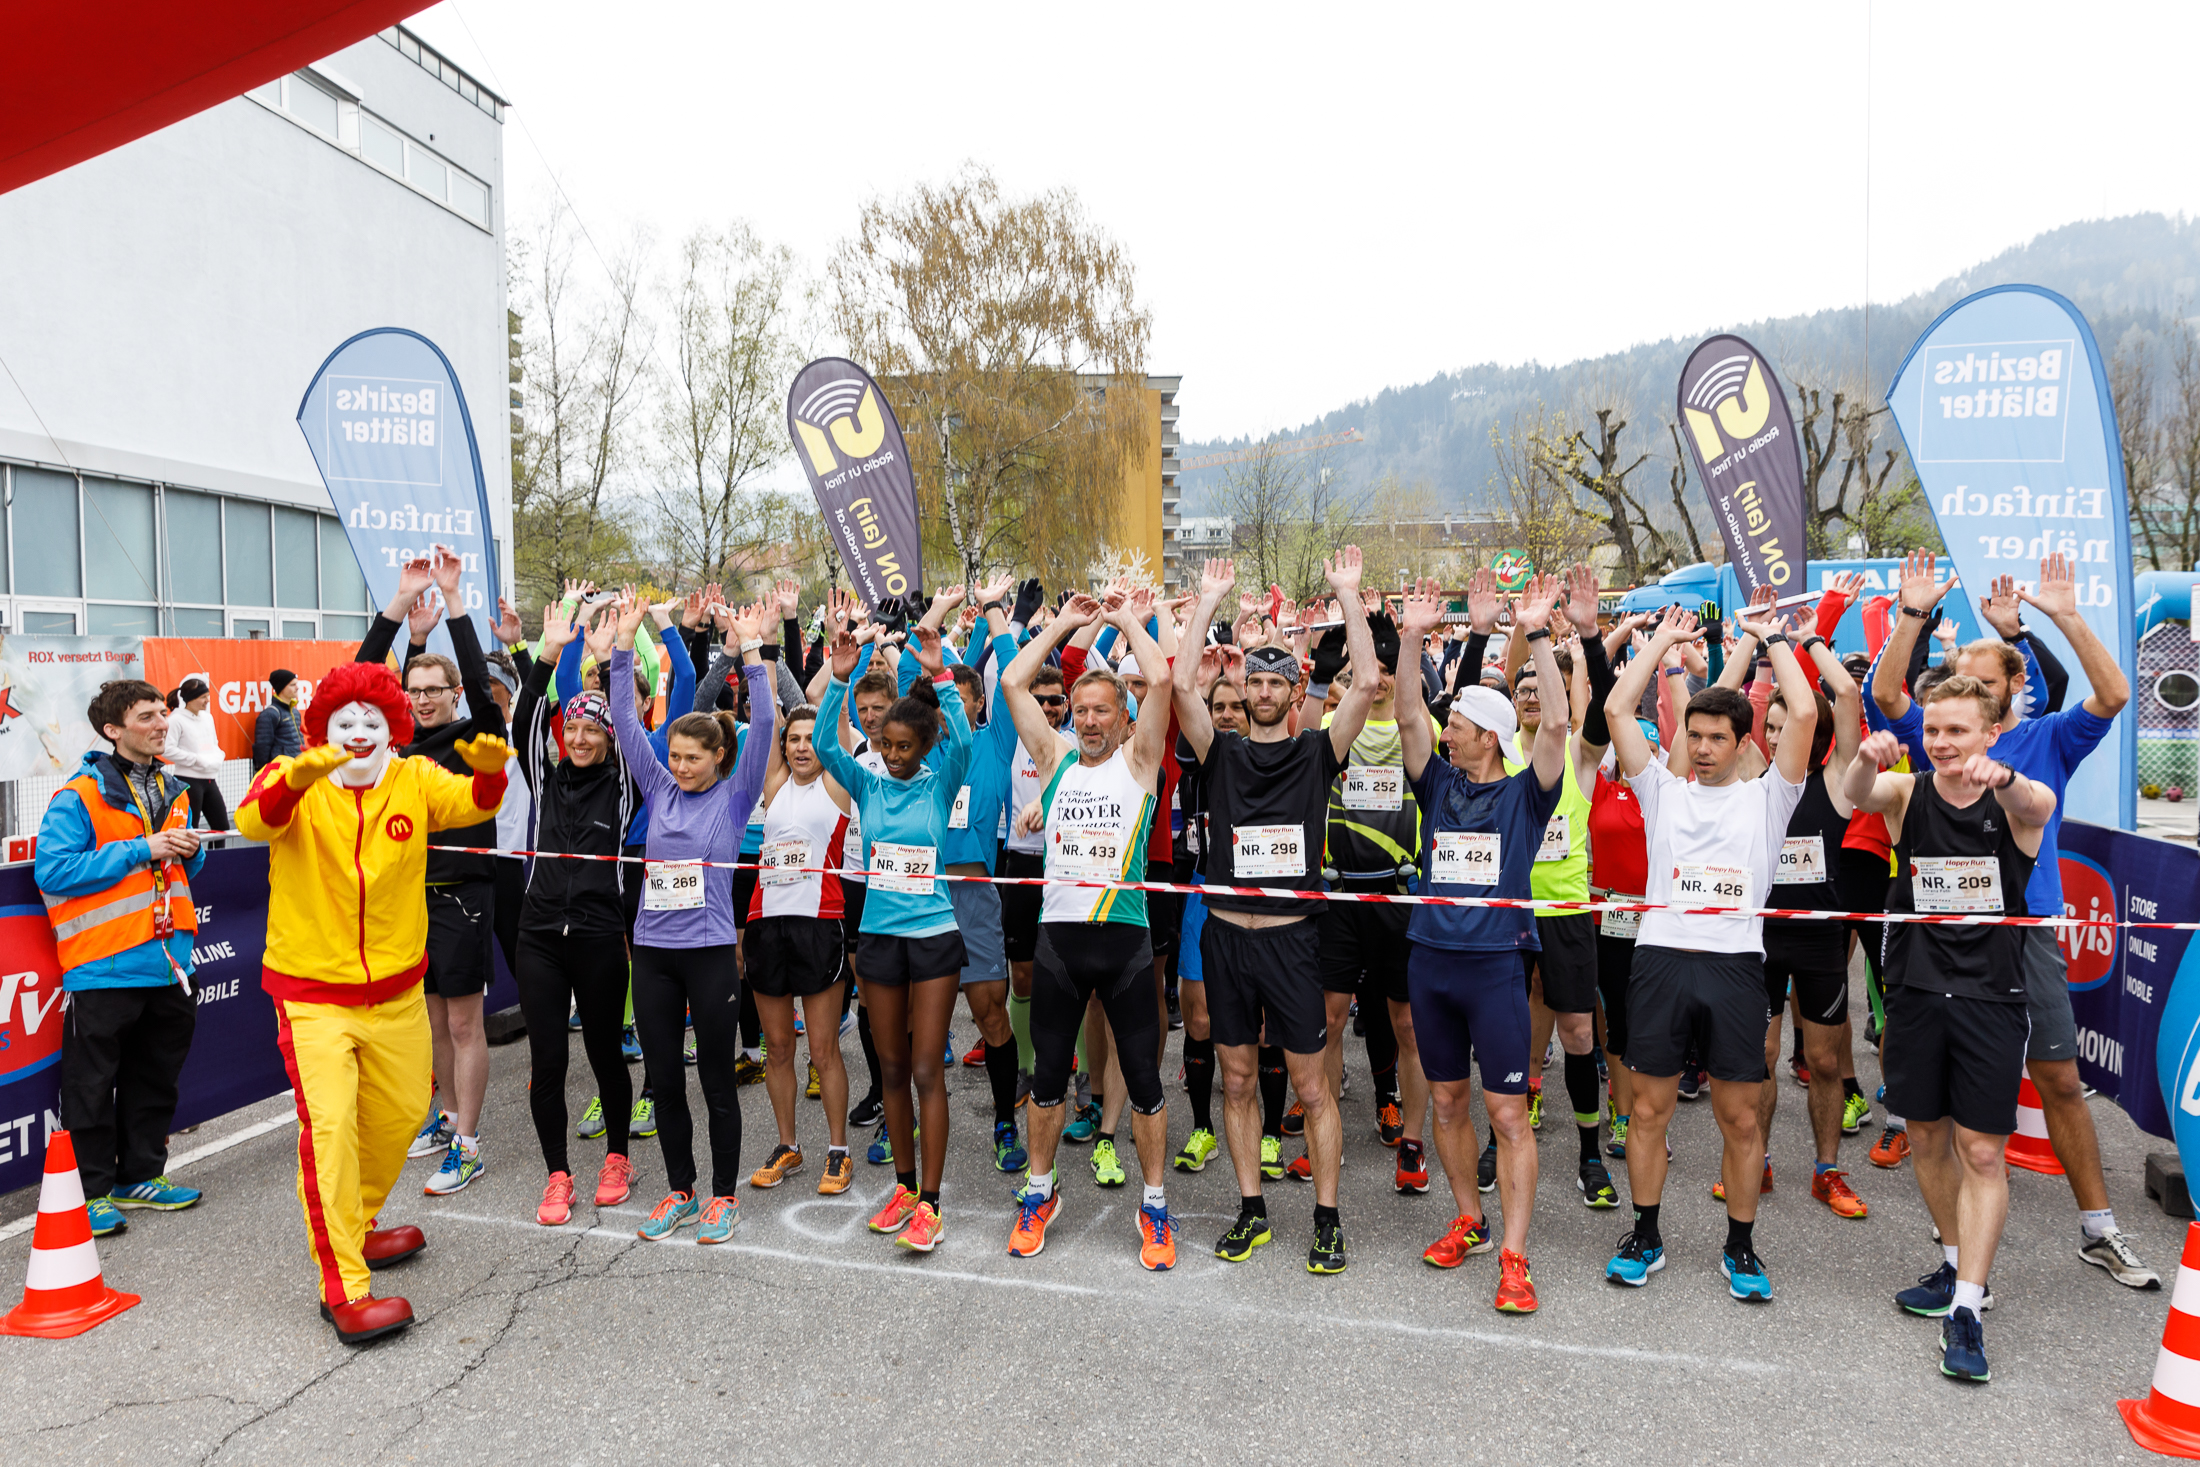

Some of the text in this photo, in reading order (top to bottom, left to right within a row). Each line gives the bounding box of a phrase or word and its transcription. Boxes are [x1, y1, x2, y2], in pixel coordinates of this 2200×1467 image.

[28, 651, 139, 665] ROX versetzt Berge.
[1349, 781, 1397, 792] NR. 252
[1057, 804, 1121, 821] TROYER
[1547, 831, 1563, 841] 24
[1062, 844, 1116, 858] NR. 433
[1242, 843, 1297, 856] NR. 298
[1439, 850, 1493, 863] NR. 424
[764, 853, 806, 866] NR. 382
[1780, 853, 1812, 864] 06 A
[877, 858, 929, 874] NR. 327
[651, 876, 697, 890] NR. 268
[1681, 880, 1743, 896] NR. 426
[1922, 876, 1991, 889] NR. 209
[2131, 896, 2158, 920] STORE
[1608, 910, 1642, 921] NR. 2
[190, 941, 236, 966] NLINE
[2129, 935, 2157, 963] ONLINE
[197, 979, 240, 1006] OBILE
[2127, 975, 2153, 1004] MOBILE
[0, 1114, 35, 1166] ET
